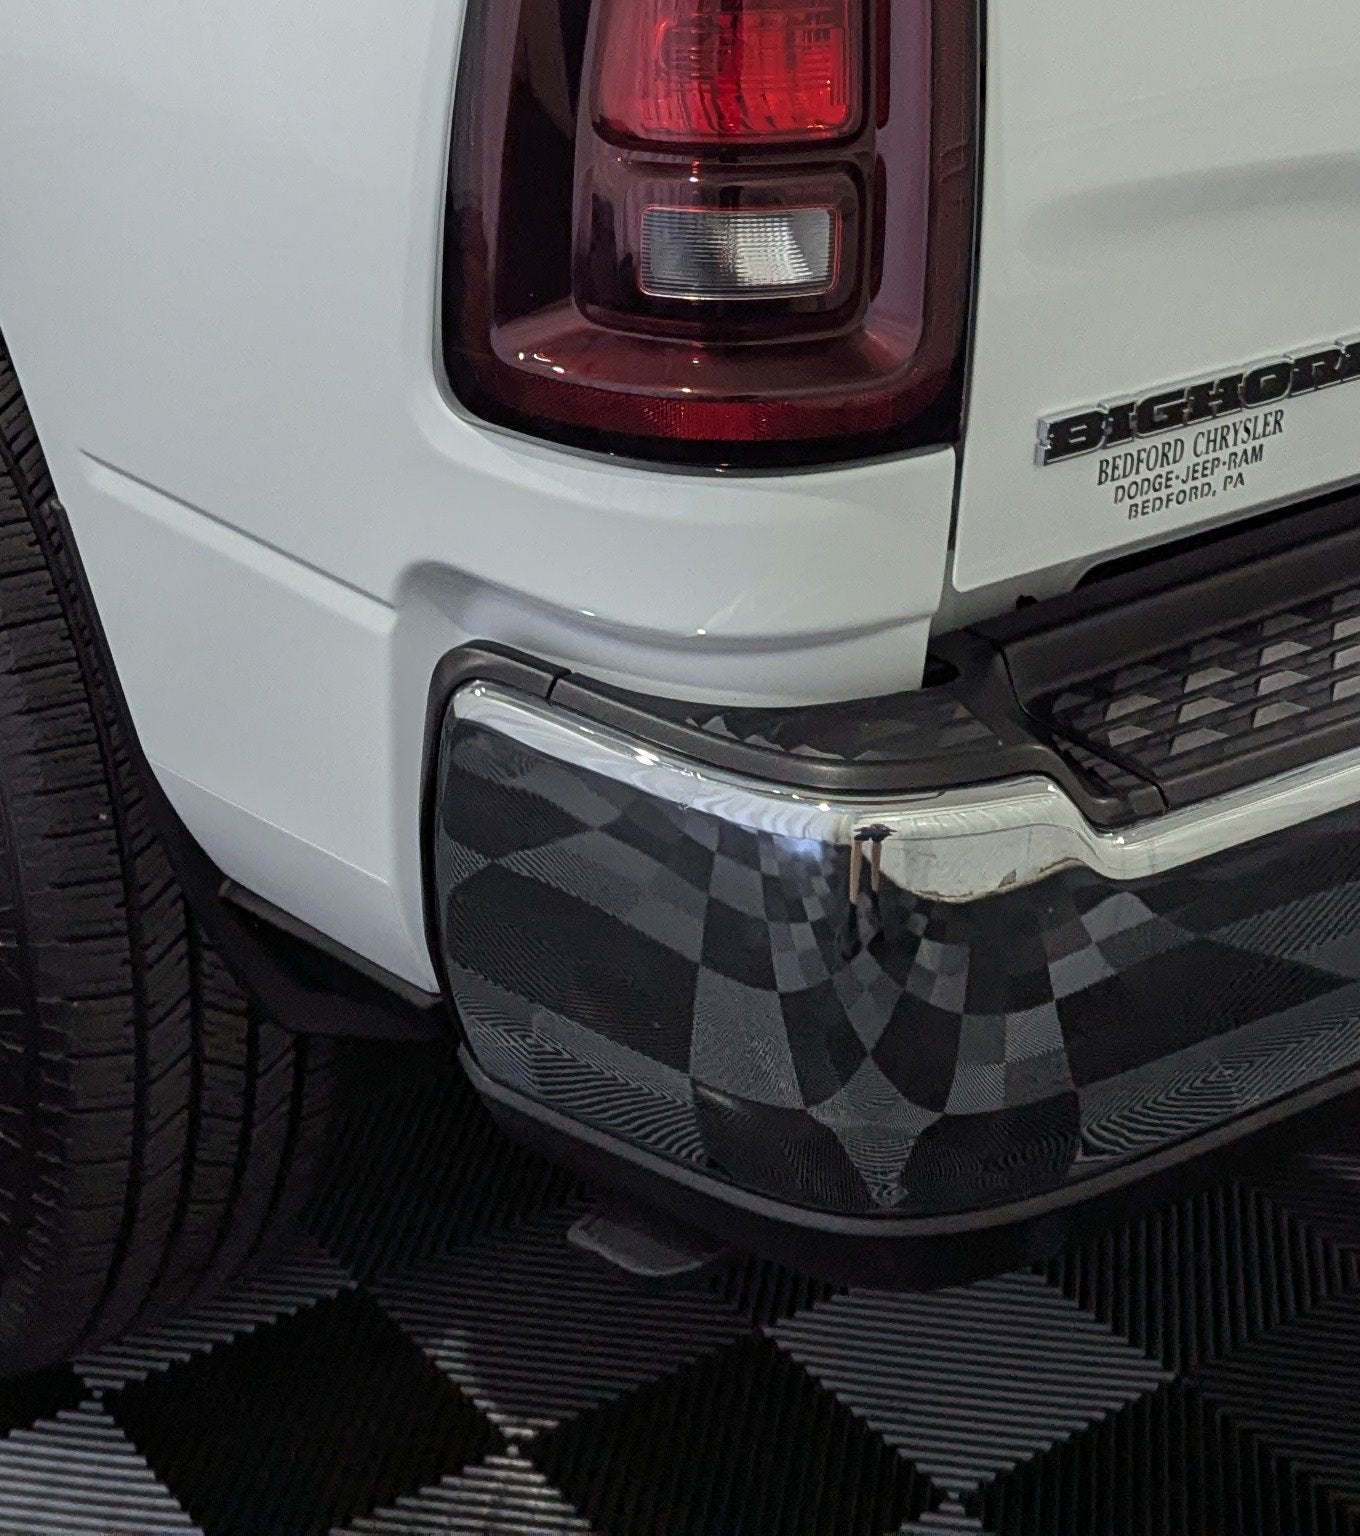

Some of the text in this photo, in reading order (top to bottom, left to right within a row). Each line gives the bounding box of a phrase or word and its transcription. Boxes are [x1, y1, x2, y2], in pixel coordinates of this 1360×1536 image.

[1096, 409, 1285, 486] BEDFORD CHRYSLER
[1127, 471, 1245, 520] BEDFORD, PA
